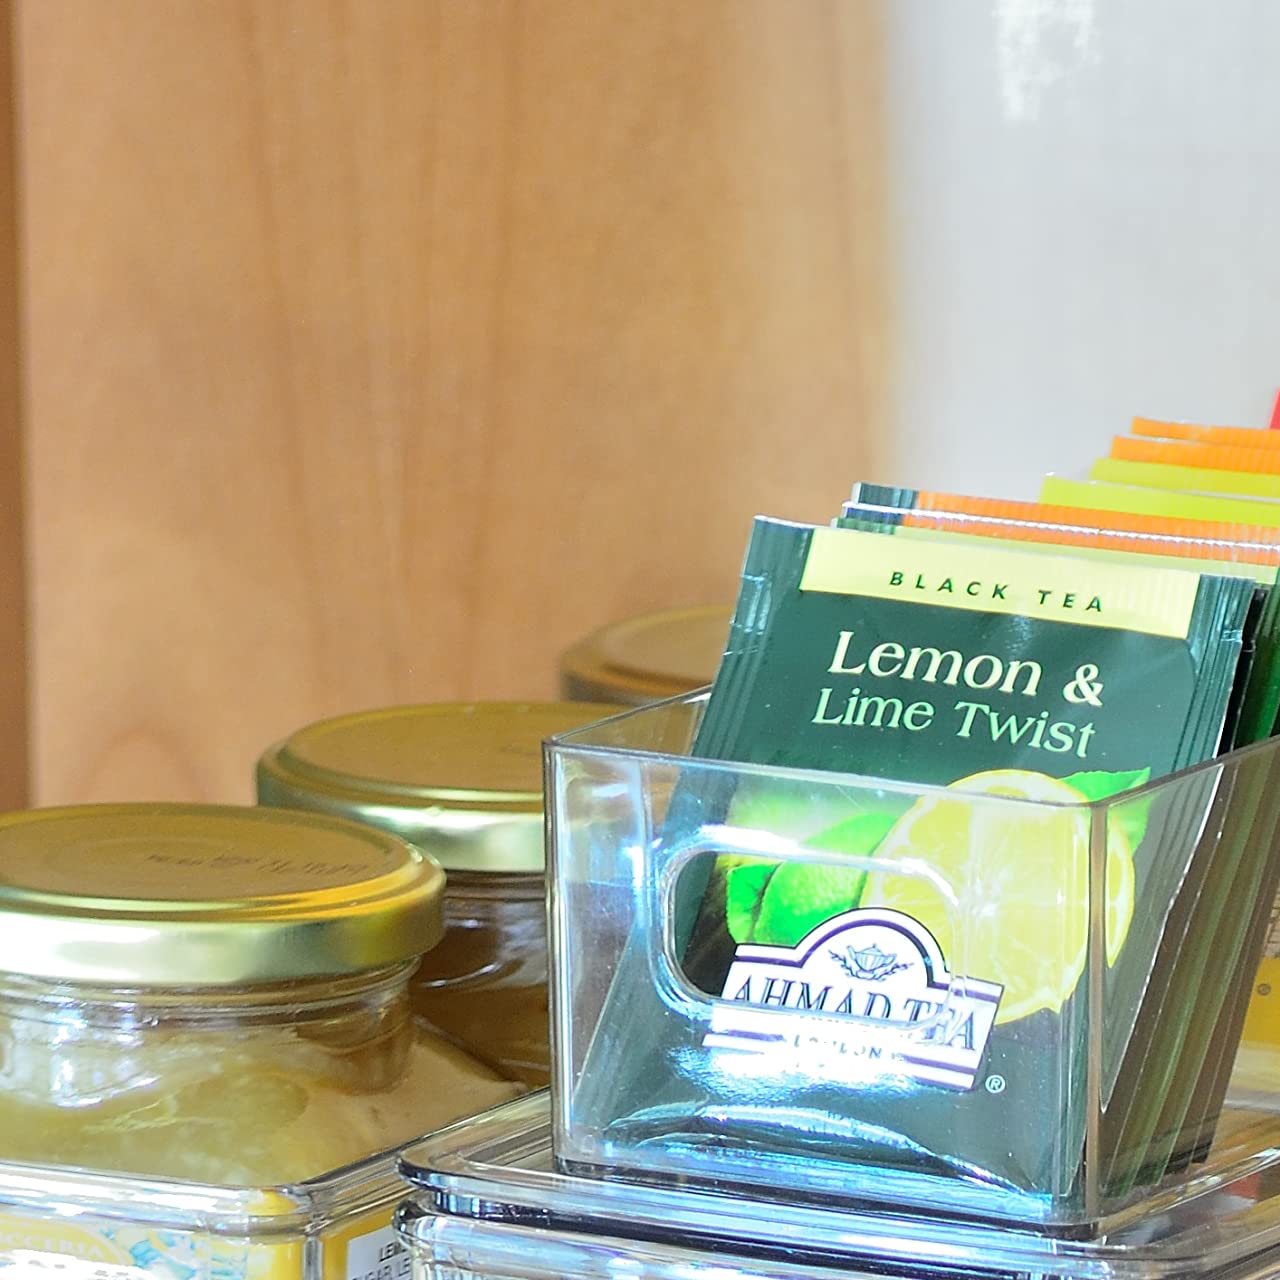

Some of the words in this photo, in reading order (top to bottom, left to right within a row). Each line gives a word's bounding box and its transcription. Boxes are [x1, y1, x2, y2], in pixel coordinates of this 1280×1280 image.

[888, 571, 1010, 600] BLACK
[1037, 589, 1103, 613] TEA
[828, 630, 1043, 697] Lemon
[1062, 662, 1105, 708] &
[810, 687, 936, 732] Lime
[954, 699, 1097, 759] Twist
[733, 973, 893, 1022] AHMAD
